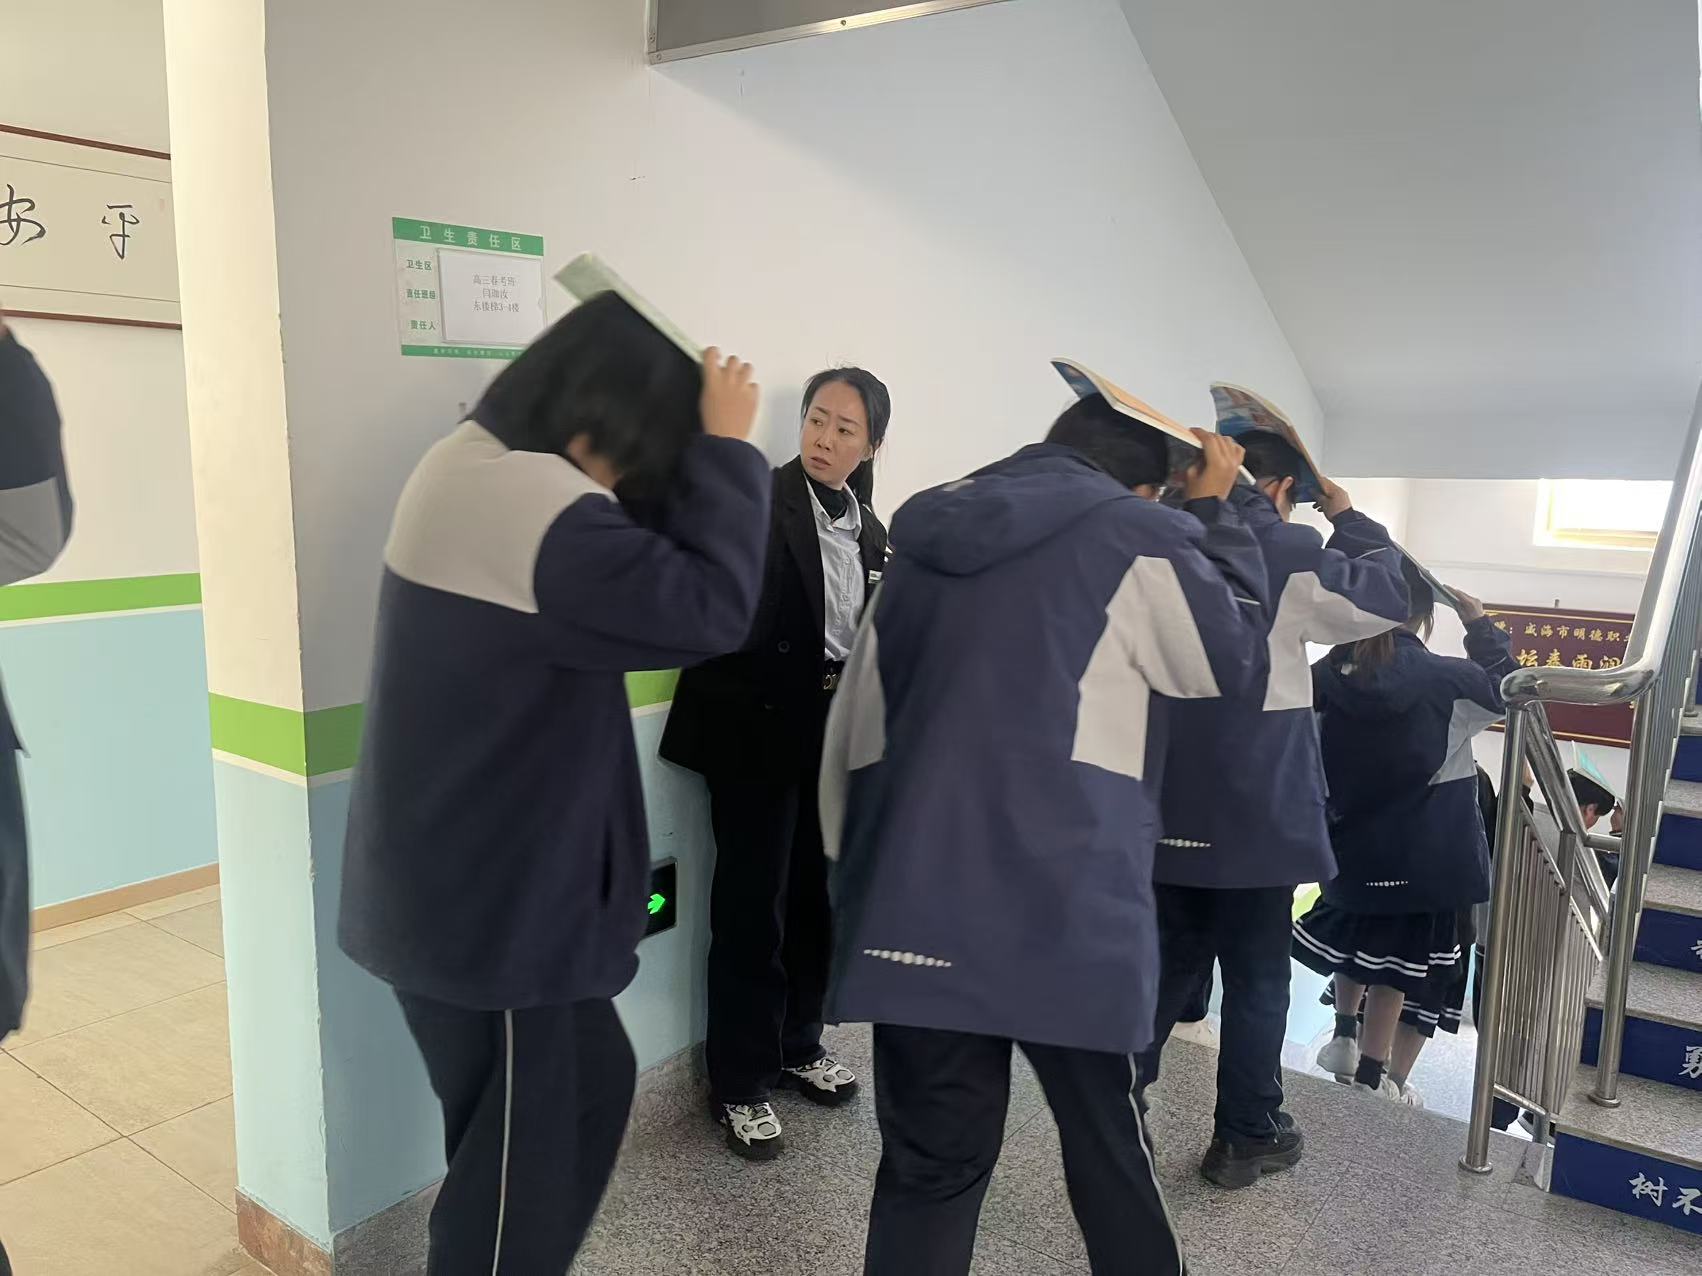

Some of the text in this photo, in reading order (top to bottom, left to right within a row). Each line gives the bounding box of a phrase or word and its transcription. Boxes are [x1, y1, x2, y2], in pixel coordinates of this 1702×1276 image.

[419, 225, 522, 250] 卫生责任区
[406, 259, 432, 271] 卫生区
[410, 319, 436, 330] 责任人
